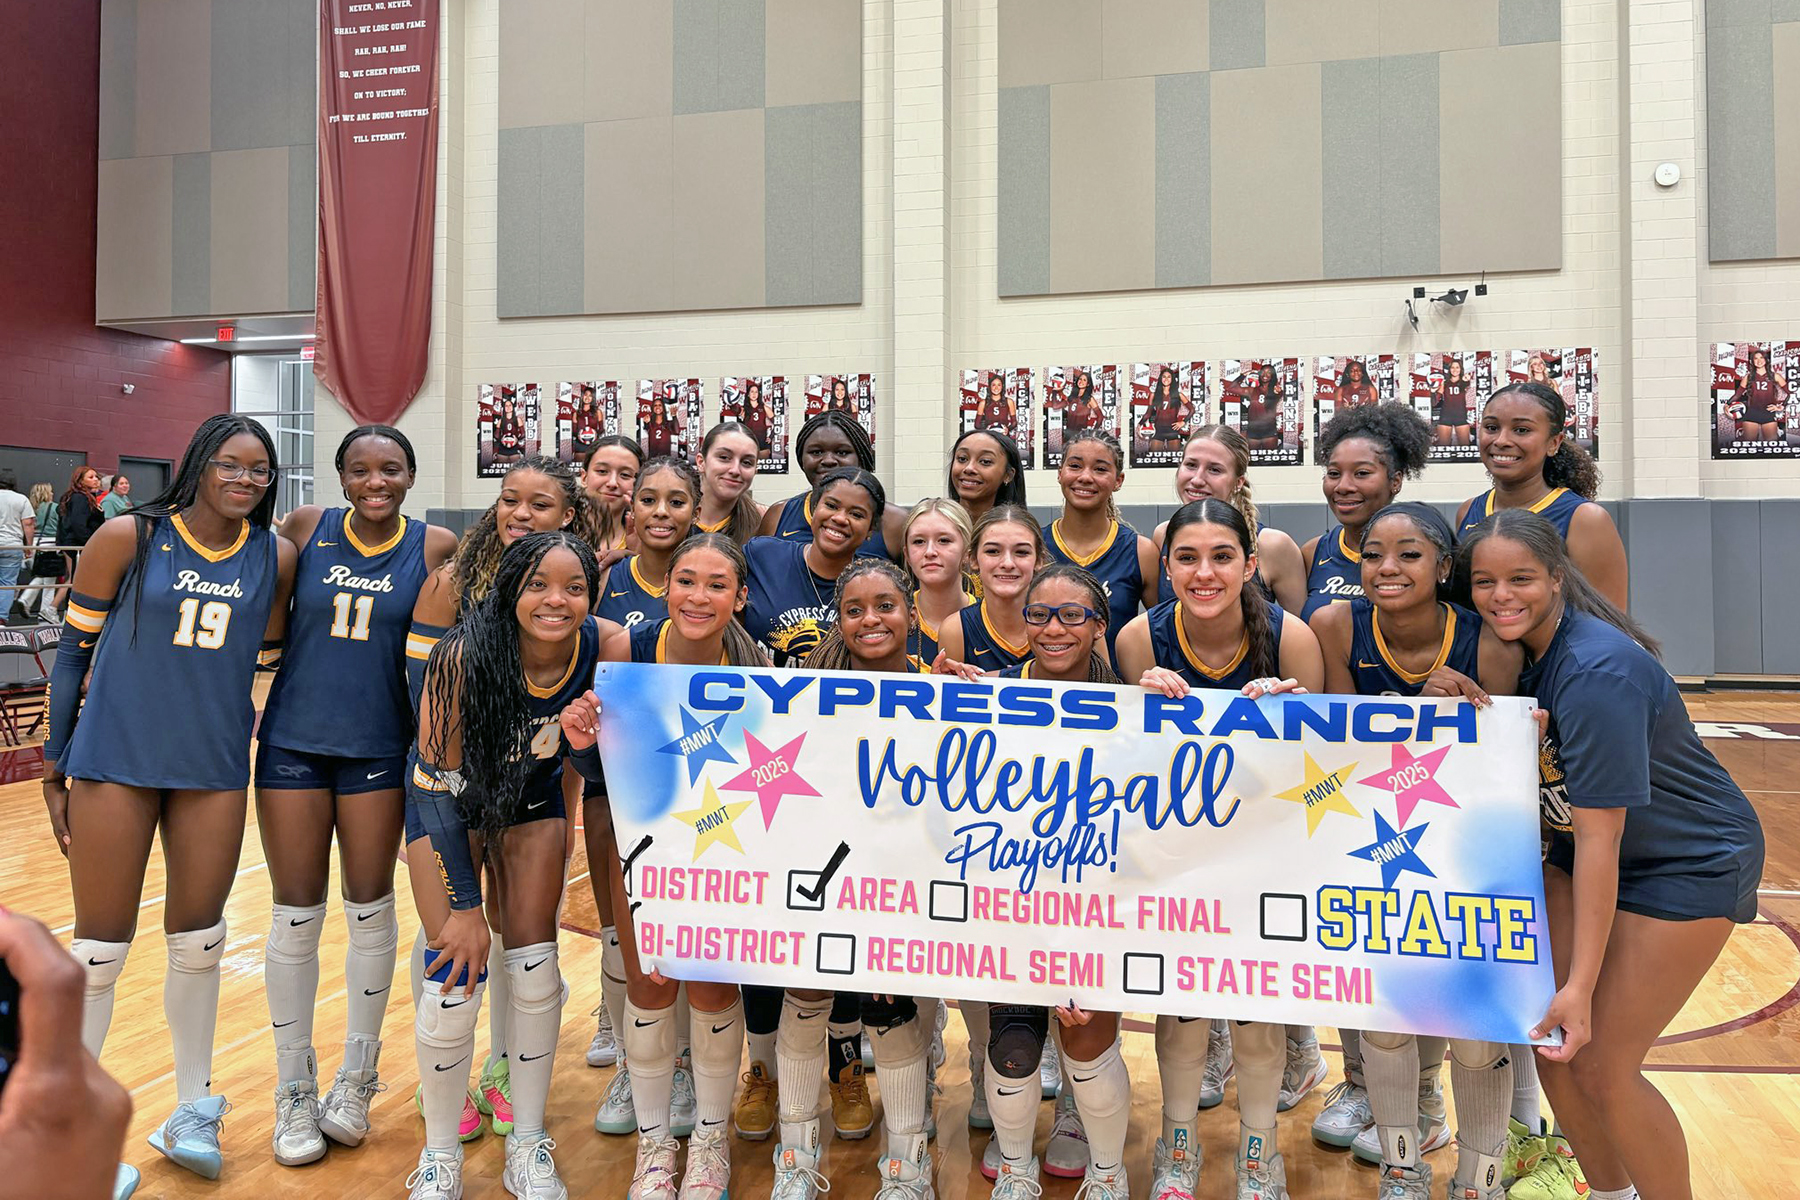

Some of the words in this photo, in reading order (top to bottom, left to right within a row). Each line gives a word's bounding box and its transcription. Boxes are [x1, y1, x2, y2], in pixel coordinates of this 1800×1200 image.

[349, 4, 374, 12] NEVER,
[375, 2, 386, 10] NO,
[388, 0, 412, 8] NEVER,
[334, 26, 358, 35] SHALL
[372, 24, 390, 32] LOSE
[406, 20, 426, 29] FAME
[372, 46, 388, 54] RAH,
[390, 44, 406, 52] RAH!
[366, 68, 387, 76] CHEER
[389, 65, 420, 74] FOREVER
[342, 114, 354, 122] WE
[357, 113, 370, 121] ARE
[372, 111, 394, 120] BOUND
[371, 132, 407, 141] ETERNITY.
[219, 328, 233, 341] EXIT
[1192, 376, 1202, 424] KEYS
[1258, 395, 1265, 403] 8
[1284, 372, 1295, 432] FRANK
[1378, 370, 1392, 402] WIN
[1449, 386, 1460, 394] 10
[1578, 363, 1588, 439] HIEBER
[1756, 381, 1768, 390] 12
[1787, 356, 1799, 429] MCCAIN
[525, 396, 537, 439] WEBB
[585, 416, 588, 425] 1
[688, 392, 697, 452] BAILEY
[753, 413, 759, 421] 3
[774, 390, 782, 452] NICHOLS
[1017, 381, 1027, 450] ECKERMAN
[1103, 380, 1114, 431] KEYS
[1163, 401, 1168, 410] 7
[656, 430, 661, 439] 2
[173, 569, 244, 599] Ranch
[322, 564, 394, 594] Ranch
[172, 597, 232, 650] 19
[330, 592, 374, 641] 11
[779, 607, 825, 627] CYPRESS
[687, 672, 1119, 731] CYPRESS
[1142, 691, 1480, 745] RANCH
[679, 722, 720, 756] #MWT
[750, 754, 790, 788] 2025
[856, 727, 1242, 838] Volleyball
[1387, 760, 1430, 796] 2025
[1302, 772, 1344, 810] #MWT
[695, 805, 729, 836] #MWT
[944, 808, 1120, 895] Playoffs!
[1370, 832, 1414, 867] #MWT
[641, 866, 770, 905] DISTRICT
[836, 876, 920, 916] AREA
[972, 885, 1125, 930] REGIONAL
[1137, 896, 1232, 934] FINAL
[1316, 884, 1539, 965] STATE
[640, 921, 806, 966] BI-DISTRICT
[866, 936, 1016, 982] REGIONAL
[1028, 950, 1104, 988] SEMI
[1176, 956, 1279, 998] STATE
[1291, 963, 1374, 1005] SEMI
